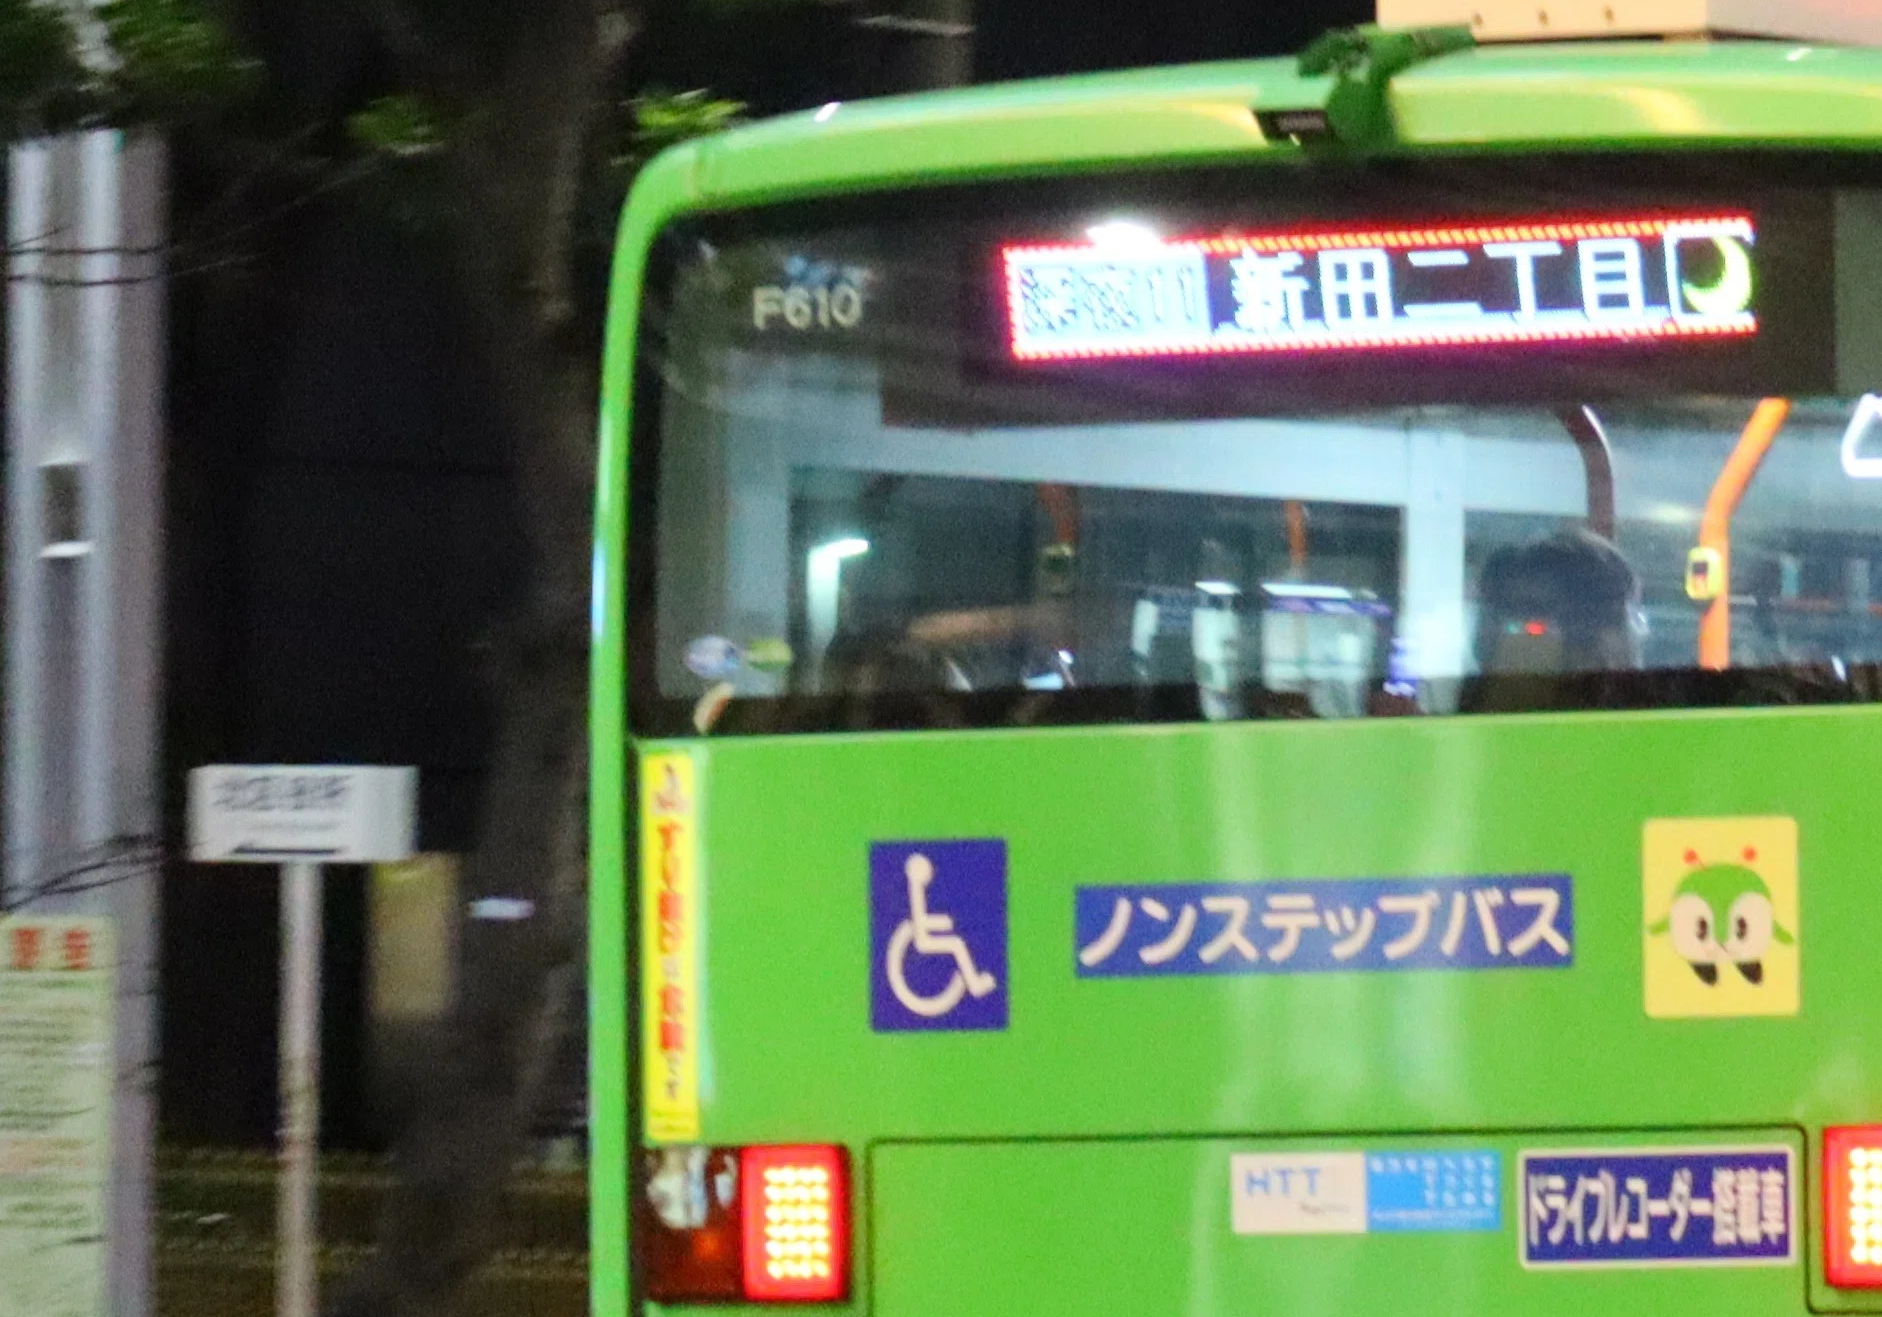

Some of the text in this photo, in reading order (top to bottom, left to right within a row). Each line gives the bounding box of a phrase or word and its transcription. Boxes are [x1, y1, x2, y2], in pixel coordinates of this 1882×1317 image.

[753, 283, 862, 332] F610
[1231, 237, 1645, 336] 新田二丁目
[1079, 885, 1571, 967] ノンステップバス
